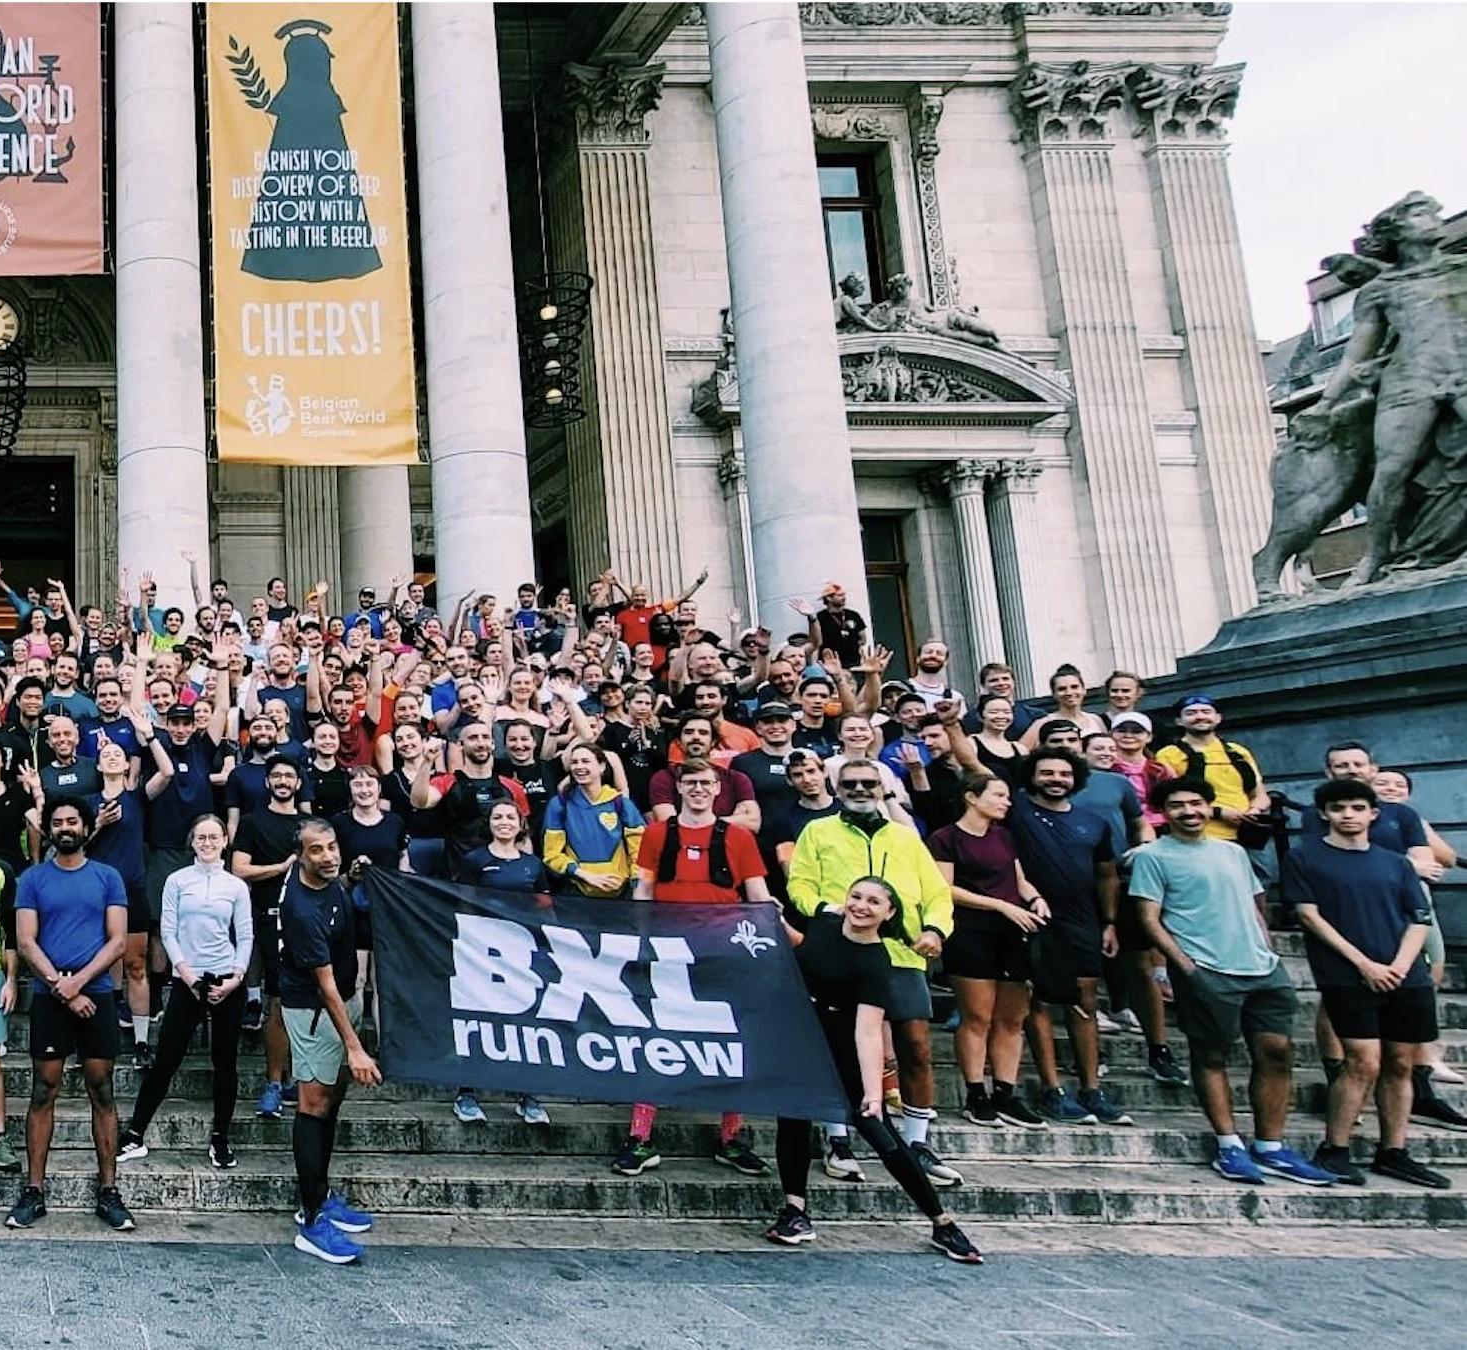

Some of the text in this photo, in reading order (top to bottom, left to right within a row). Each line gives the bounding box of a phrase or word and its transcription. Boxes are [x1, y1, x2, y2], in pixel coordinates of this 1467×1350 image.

[313, 149, 359, 171] YOUR
[318, 175, 346, 196] OF
[349, 174, 380, 197] BEER
[357, 199, 367, 222] A
[303, 225, 327, 247] THE
[331, 225, 388, 248] BEERLAB
[241, 300, 382, 357] CHEERS!
[299, 395, 359, 412] Belgian
[300, 410, 386, 425] Beer World
[450, 912, 739, 1034] BXL
[452, 1017, 744, 1079] run crew
